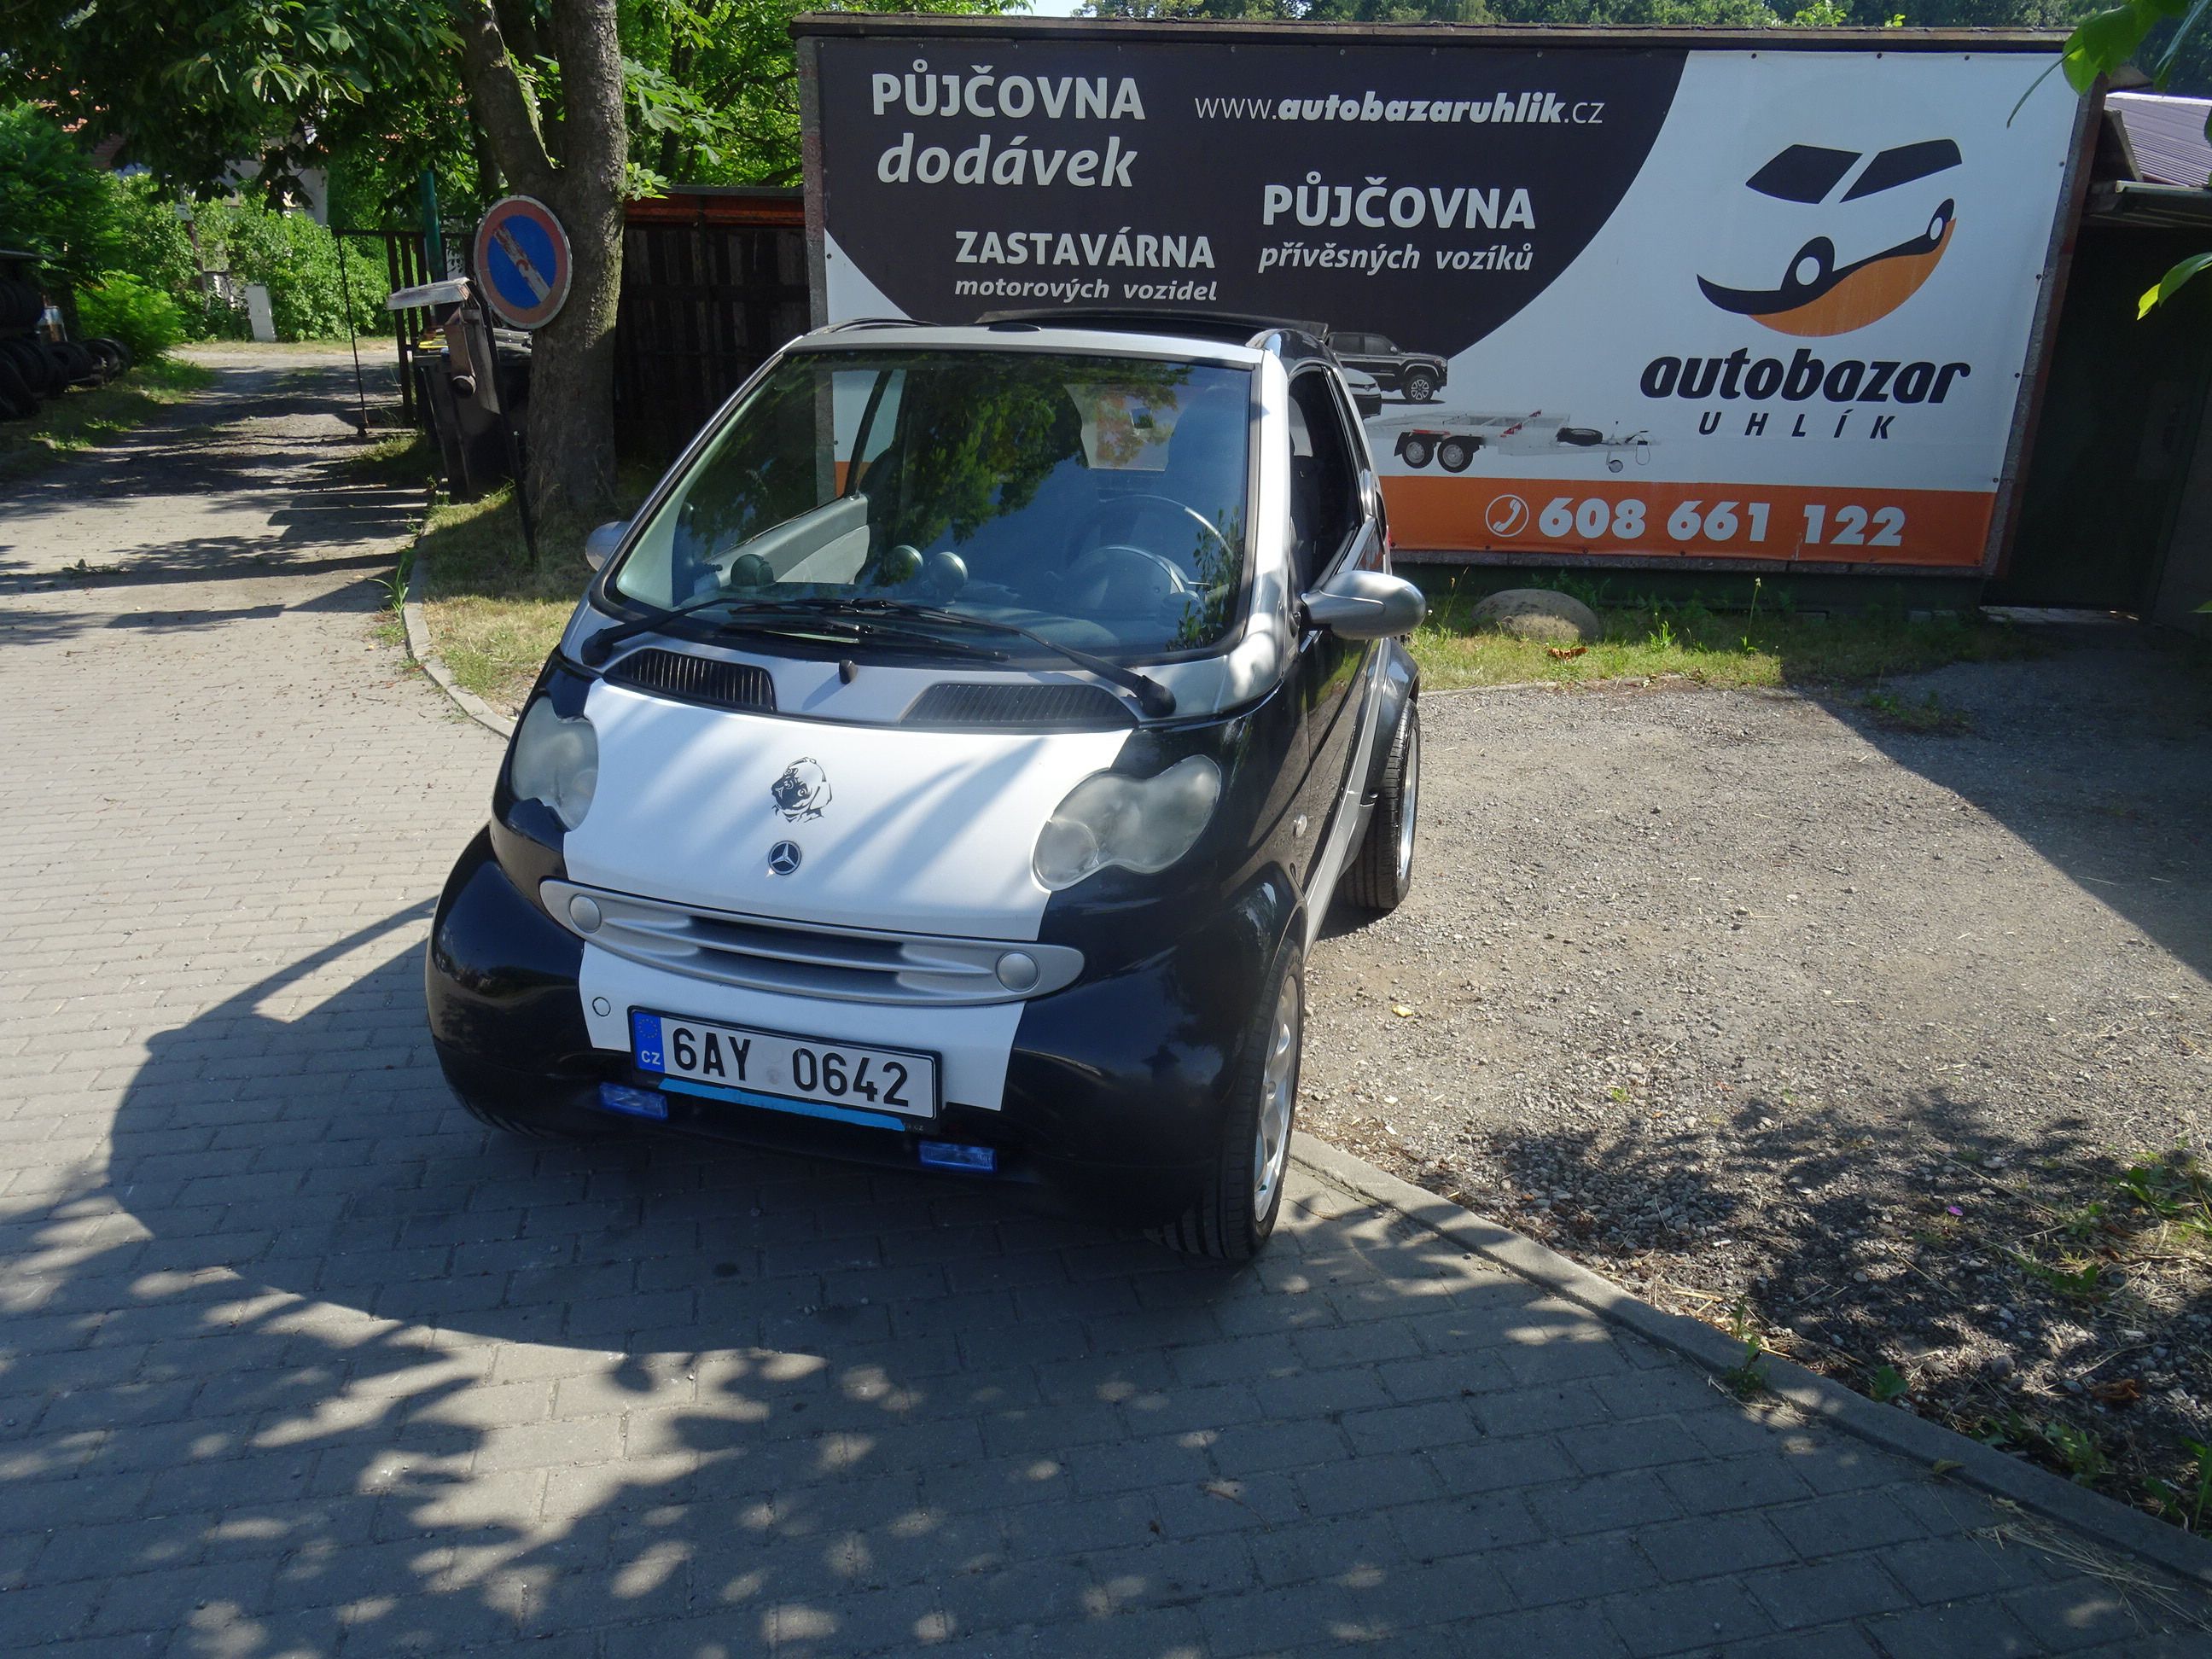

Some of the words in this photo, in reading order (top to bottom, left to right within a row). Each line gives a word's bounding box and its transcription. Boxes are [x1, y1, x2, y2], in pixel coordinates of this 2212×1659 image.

[871, 59, 1146, 120] PŮJČOVNA
[1195, 90, 1606, 125] www.autobazaruhlik.cz
[877, 132, 1138, 188] dodávek
[1262, 171, 1536, 230] PŮJČOVNA
[955, 226, 1215, 269] ZASTAVÁRNA
[1258, 242, 1421, 276] přívěsných
[1435, 242, 1534, 271] vozíků
[954, 276, 1109, 303] motorových
[1124, 280, 1218, 301] vozidel
[1639, 347, 1970, 404] autobazar
[1697, 408, 1896, 440] UHLÍK
[1538, 497, 1647, 539] 608
[1666, 500, 1771, 543] 661
[1803, 504, 1906, 547] 122
[640, 1050, 661, 1067] CZ
[672, 1027, 751, 1082] 6AY
[792, 1047, 910, 1108] 0642
